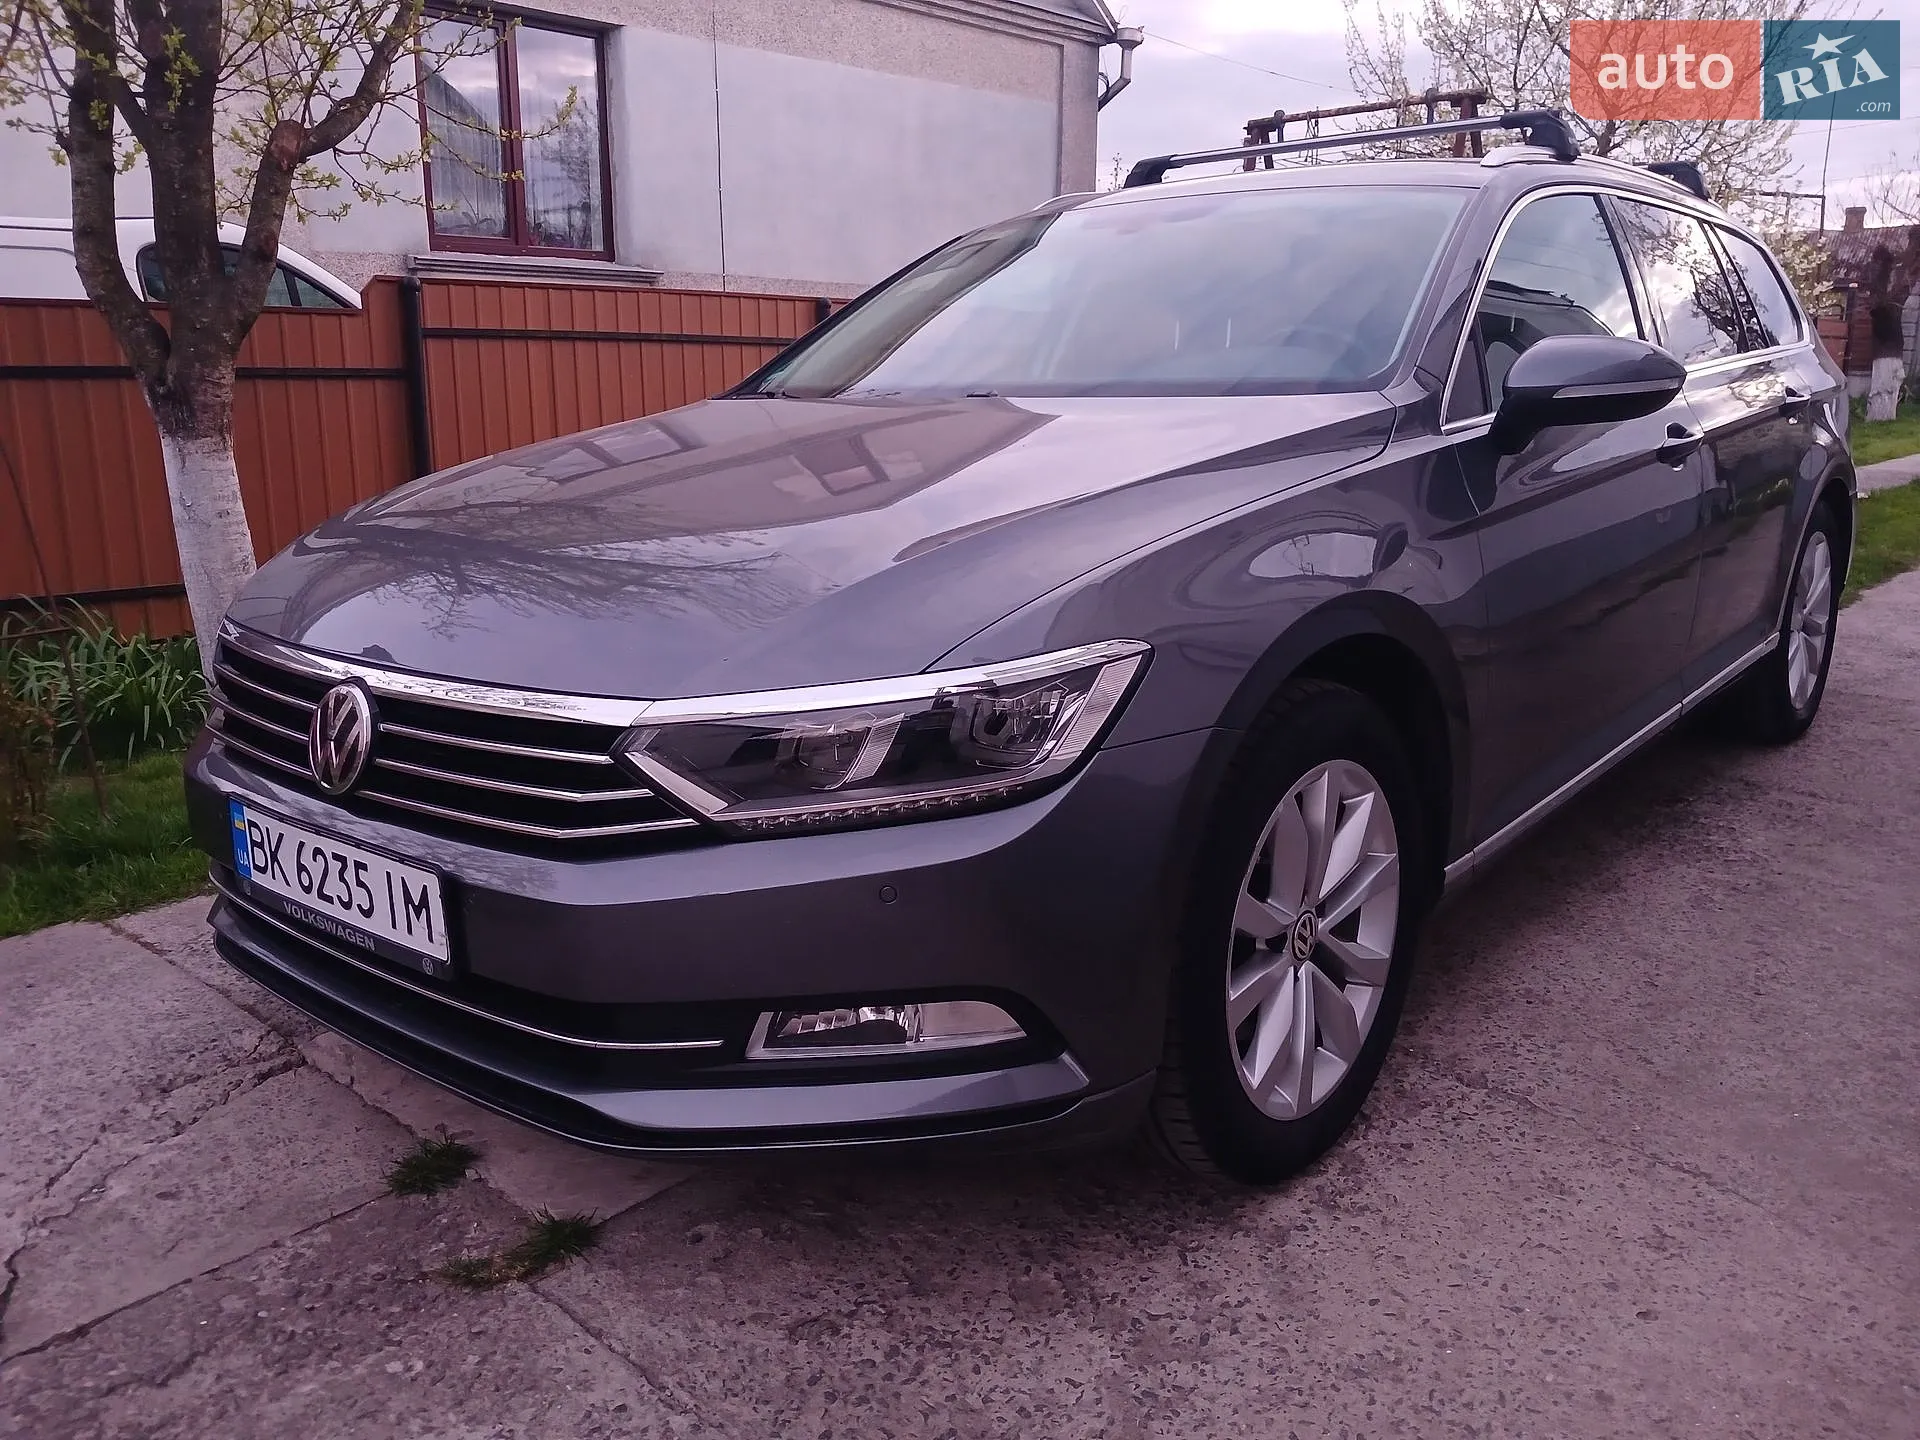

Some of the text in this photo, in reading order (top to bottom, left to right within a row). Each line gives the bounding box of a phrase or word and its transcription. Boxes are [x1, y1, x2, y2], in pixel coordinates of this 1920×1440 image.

[237, 848, 250, 868] UA
[246, 818, 434, 944] BK 6235 IM
[283, 901, 376, 952] VOLKSWAGEN
